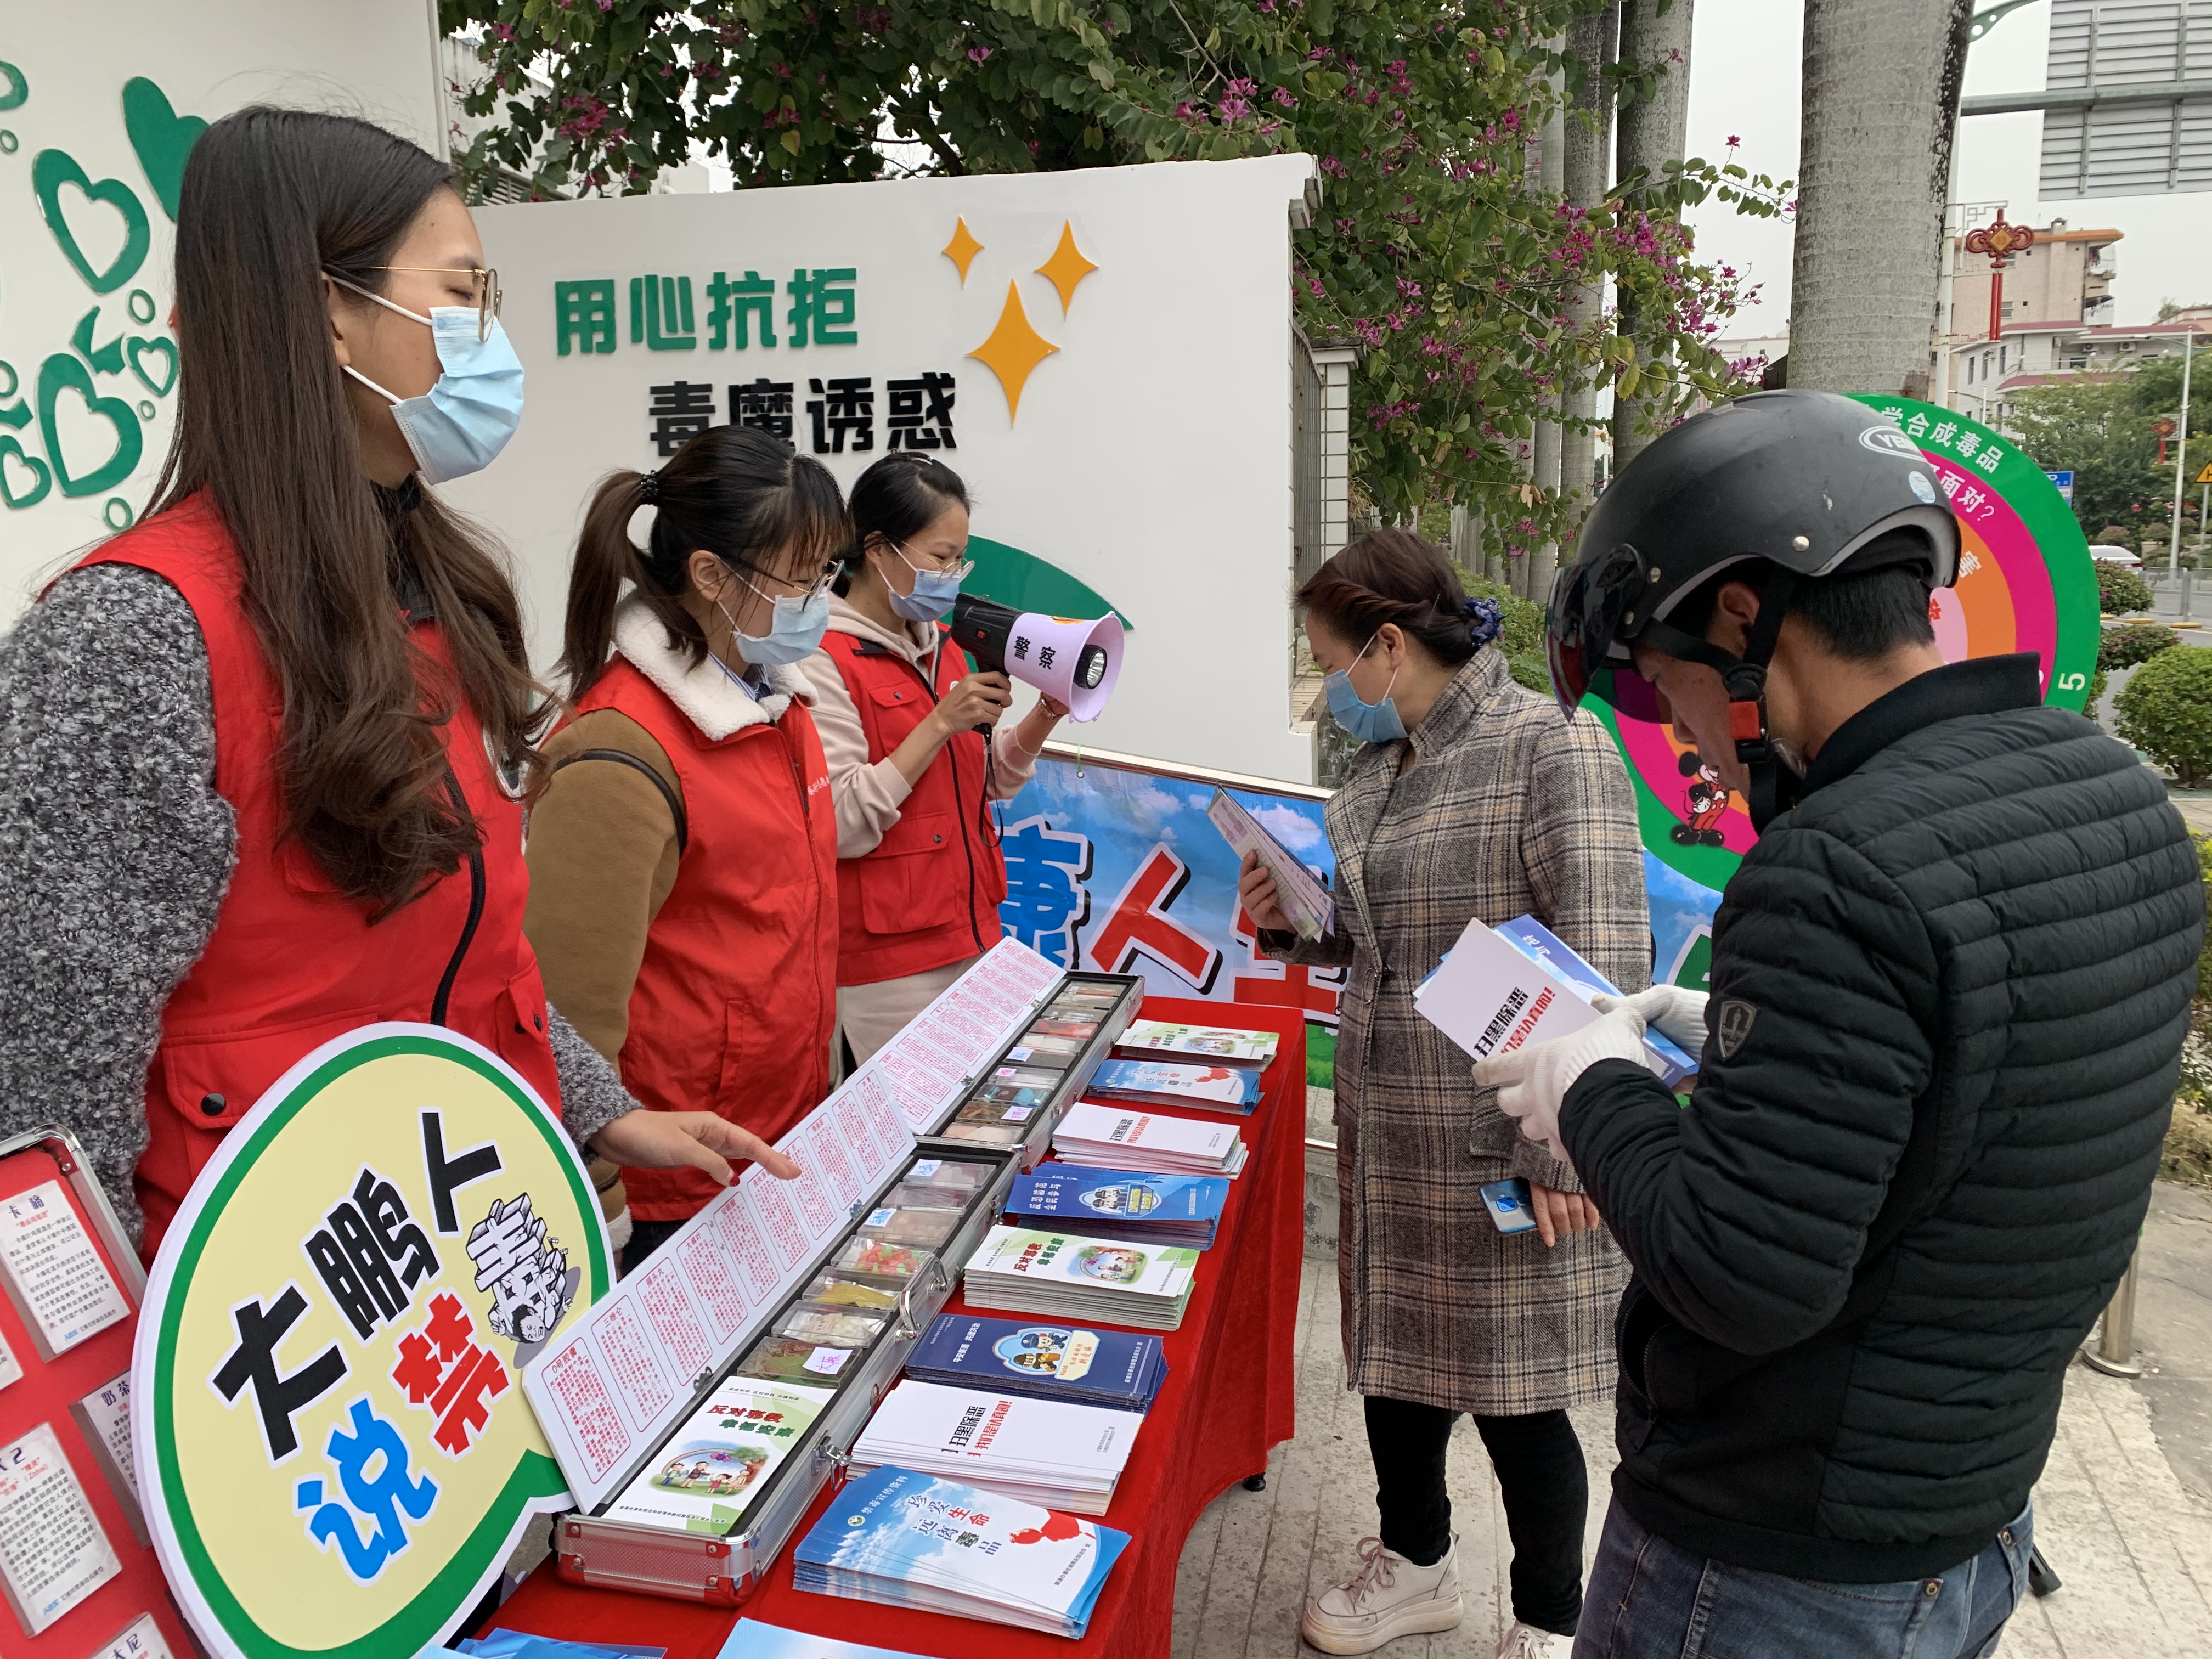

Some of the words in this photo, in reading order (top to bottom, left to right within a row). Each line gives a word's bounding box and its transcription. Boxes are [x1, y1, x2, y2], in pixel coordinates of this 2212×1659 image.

[555, 268, 857, 356] 用心抗拒
[649, 372, 957, 454] 毒魔诱惑
[1929, 463, 1995, 521] 面对?
[1014, 636, 1056, 669] 警察
[2058, 673, 2085, 690] 5
[1474, 987, 1529, 1058] 扫黑除恶
[1109, 1119, 1133, 1142] 扫黑除恶
[684, 1233, 703, 1250] 大麻叶
[1013, 1243, 1043, 1272] 反对邪教
[644, 1269, 665, 1288] 摇头丸
[551, 1346, 578, 1374] 0号胶囊
[706, 1404, 785, 1423] 反对邪教
[949, 1406, 986, 1447] 扫黑除恶
[974, 1400, 1013, 1450] 我们是认真的!
[861, 1476, 909, 1514] 禁毒宣传资料
[908, 1495, 990, 1526] 珍爱生命
[913, 1519, 1002, 1555] 远离毒品
